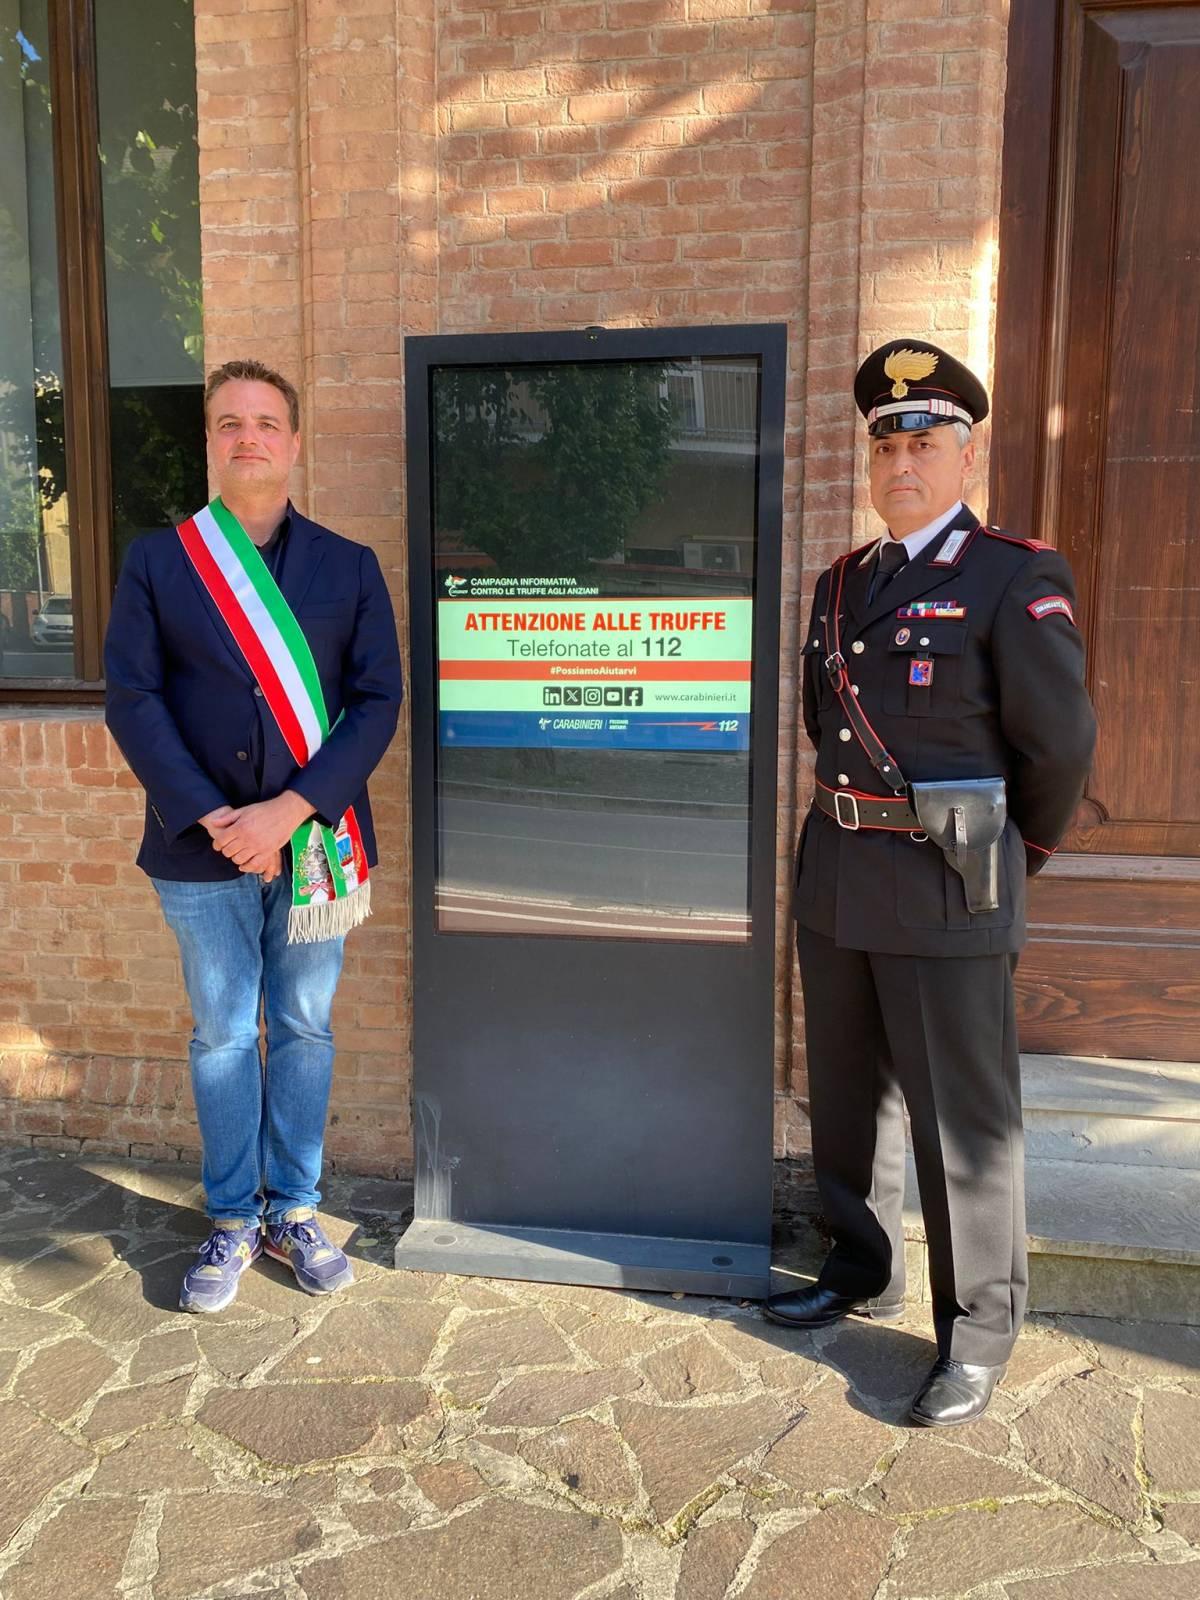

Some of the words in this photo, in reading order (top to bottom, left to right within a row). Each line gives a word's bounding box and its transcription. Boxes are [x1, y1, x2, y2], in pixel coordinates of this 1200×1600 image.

[470, 577, 519, 586] CAMPAGNA
[520, 577, 577, 586] INFORMATIVA
[470, 587, 504, 596] CONTRO
[505, 587, 515, 596] LE
[517, 587, 546, 596] TRUFFE
[547, 587, 566, 596] AGLI
[567, 587, 599, 596] ANZIANI
[464, 612, 586, 632] ATTENZIONE
[592, 612, 641, 631] ALLE
[648, 611, 726, 631] TRUFFE
[507, 639, 610, 657] Telefonate
[617, 639, 633, 657] al
[641, 637, 682, 657] 112
[550, 665, 637, 676] #PossiamoAiutarvi
[655, 693, 736, 702] www.carabinieri.it
[552, 719, 603, 730] CARABINIERI
[718, 719, 739, 732] 112
